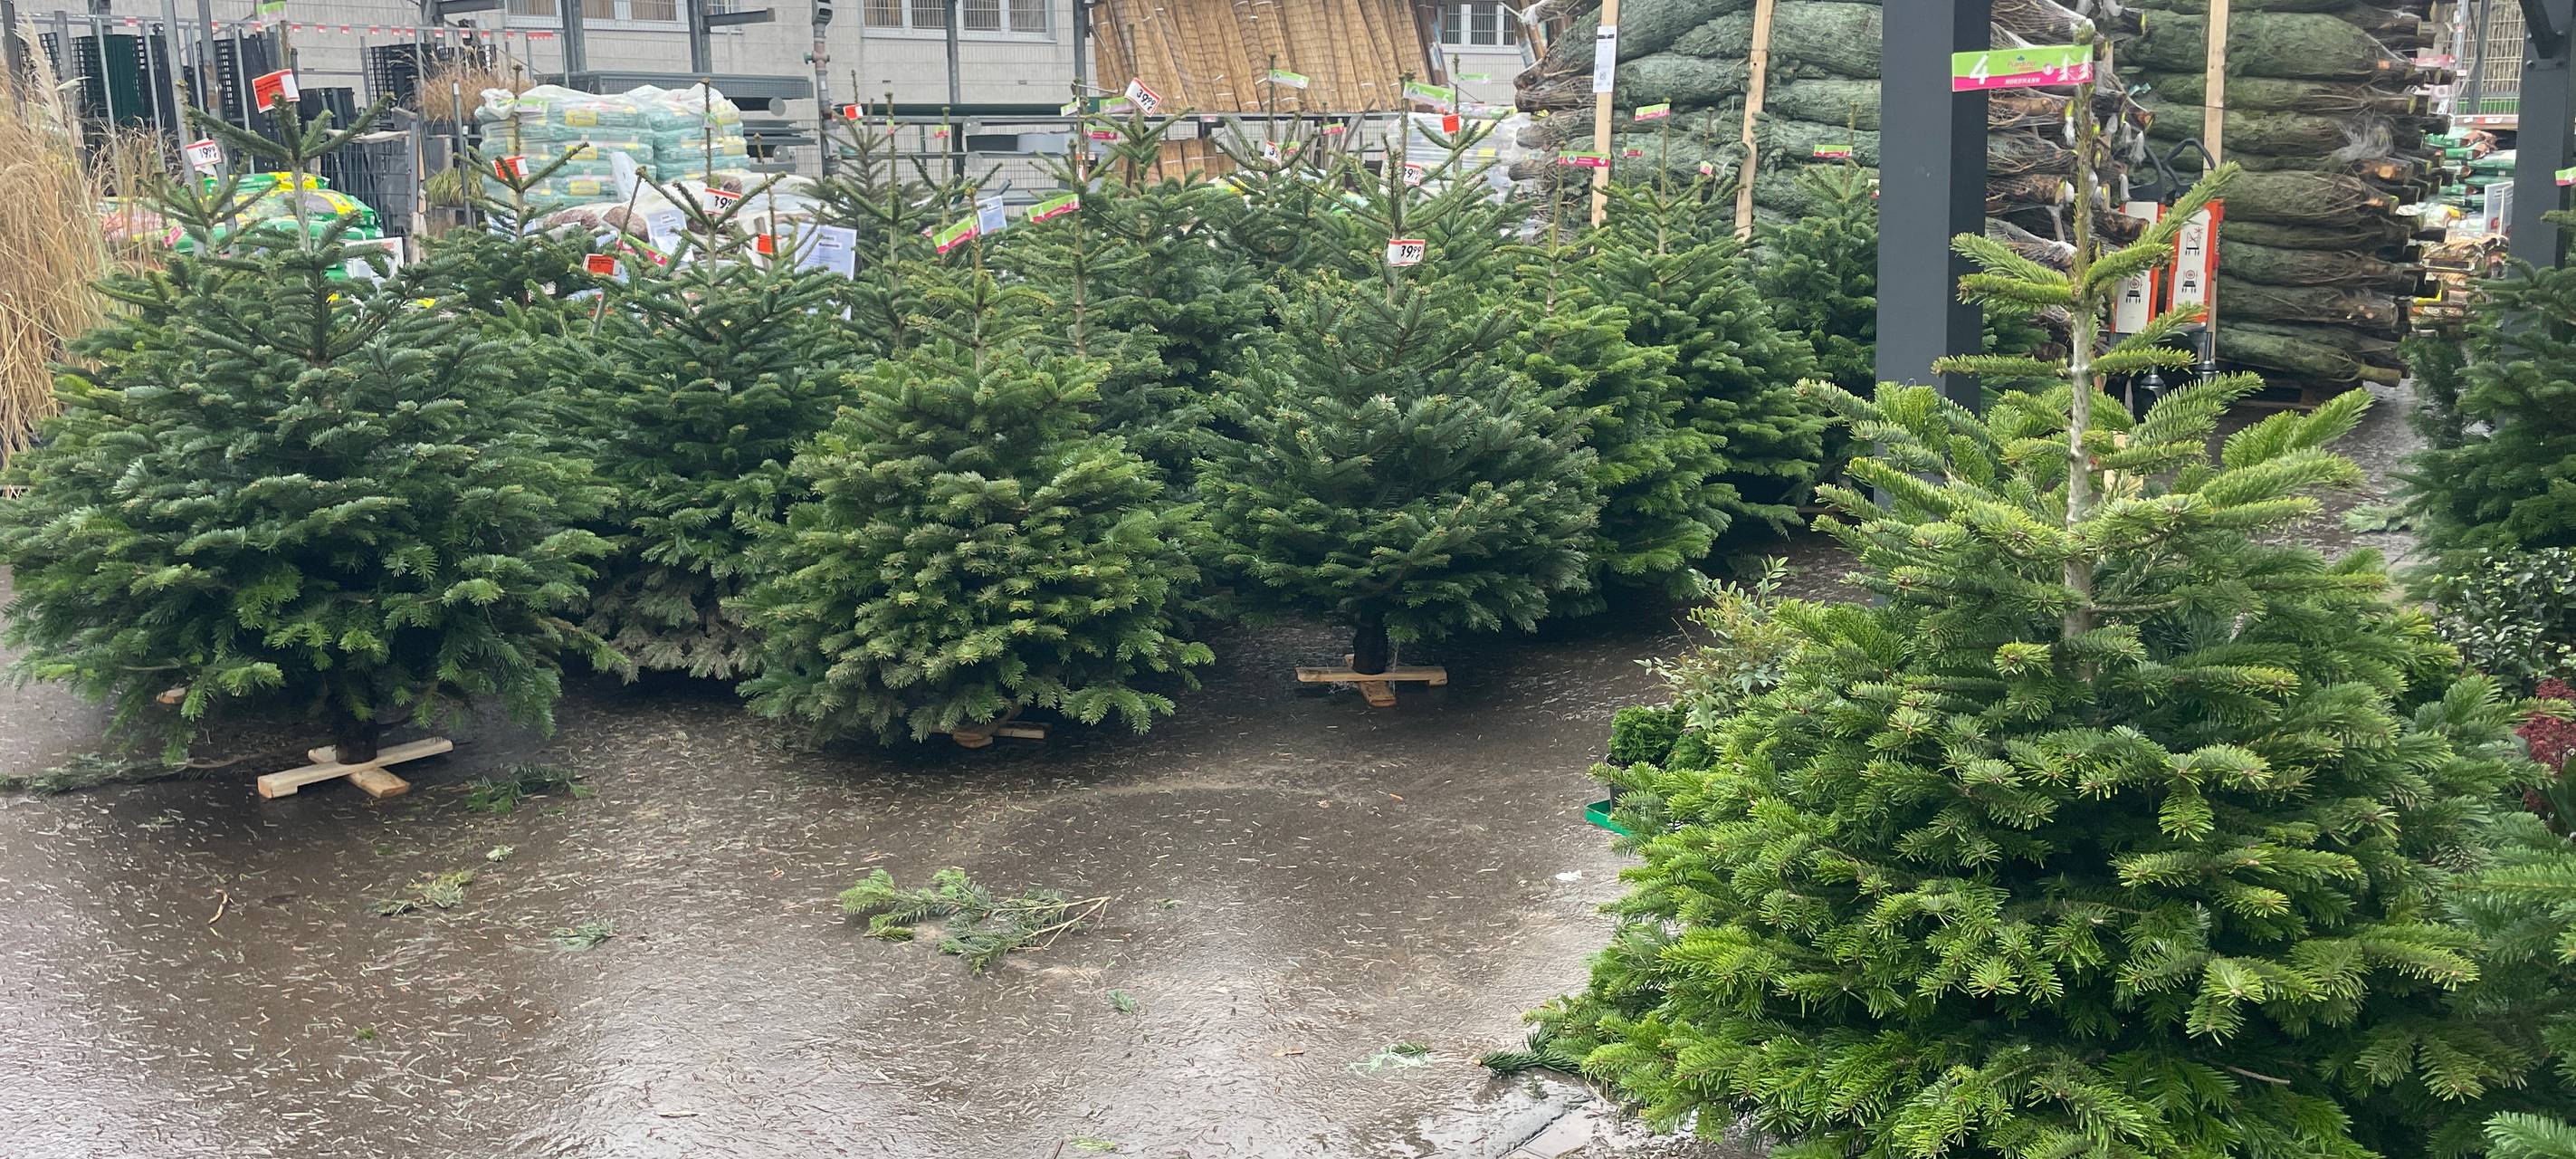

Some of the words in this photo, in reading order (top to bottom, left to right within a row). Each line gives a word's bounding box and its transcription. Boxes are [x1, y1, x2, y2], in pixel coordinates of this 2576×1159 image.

[1970, 54, 1989, 84] 4
[1442, 93, 1450, 105] 5
[1598, 155, 1607, 166] 4
